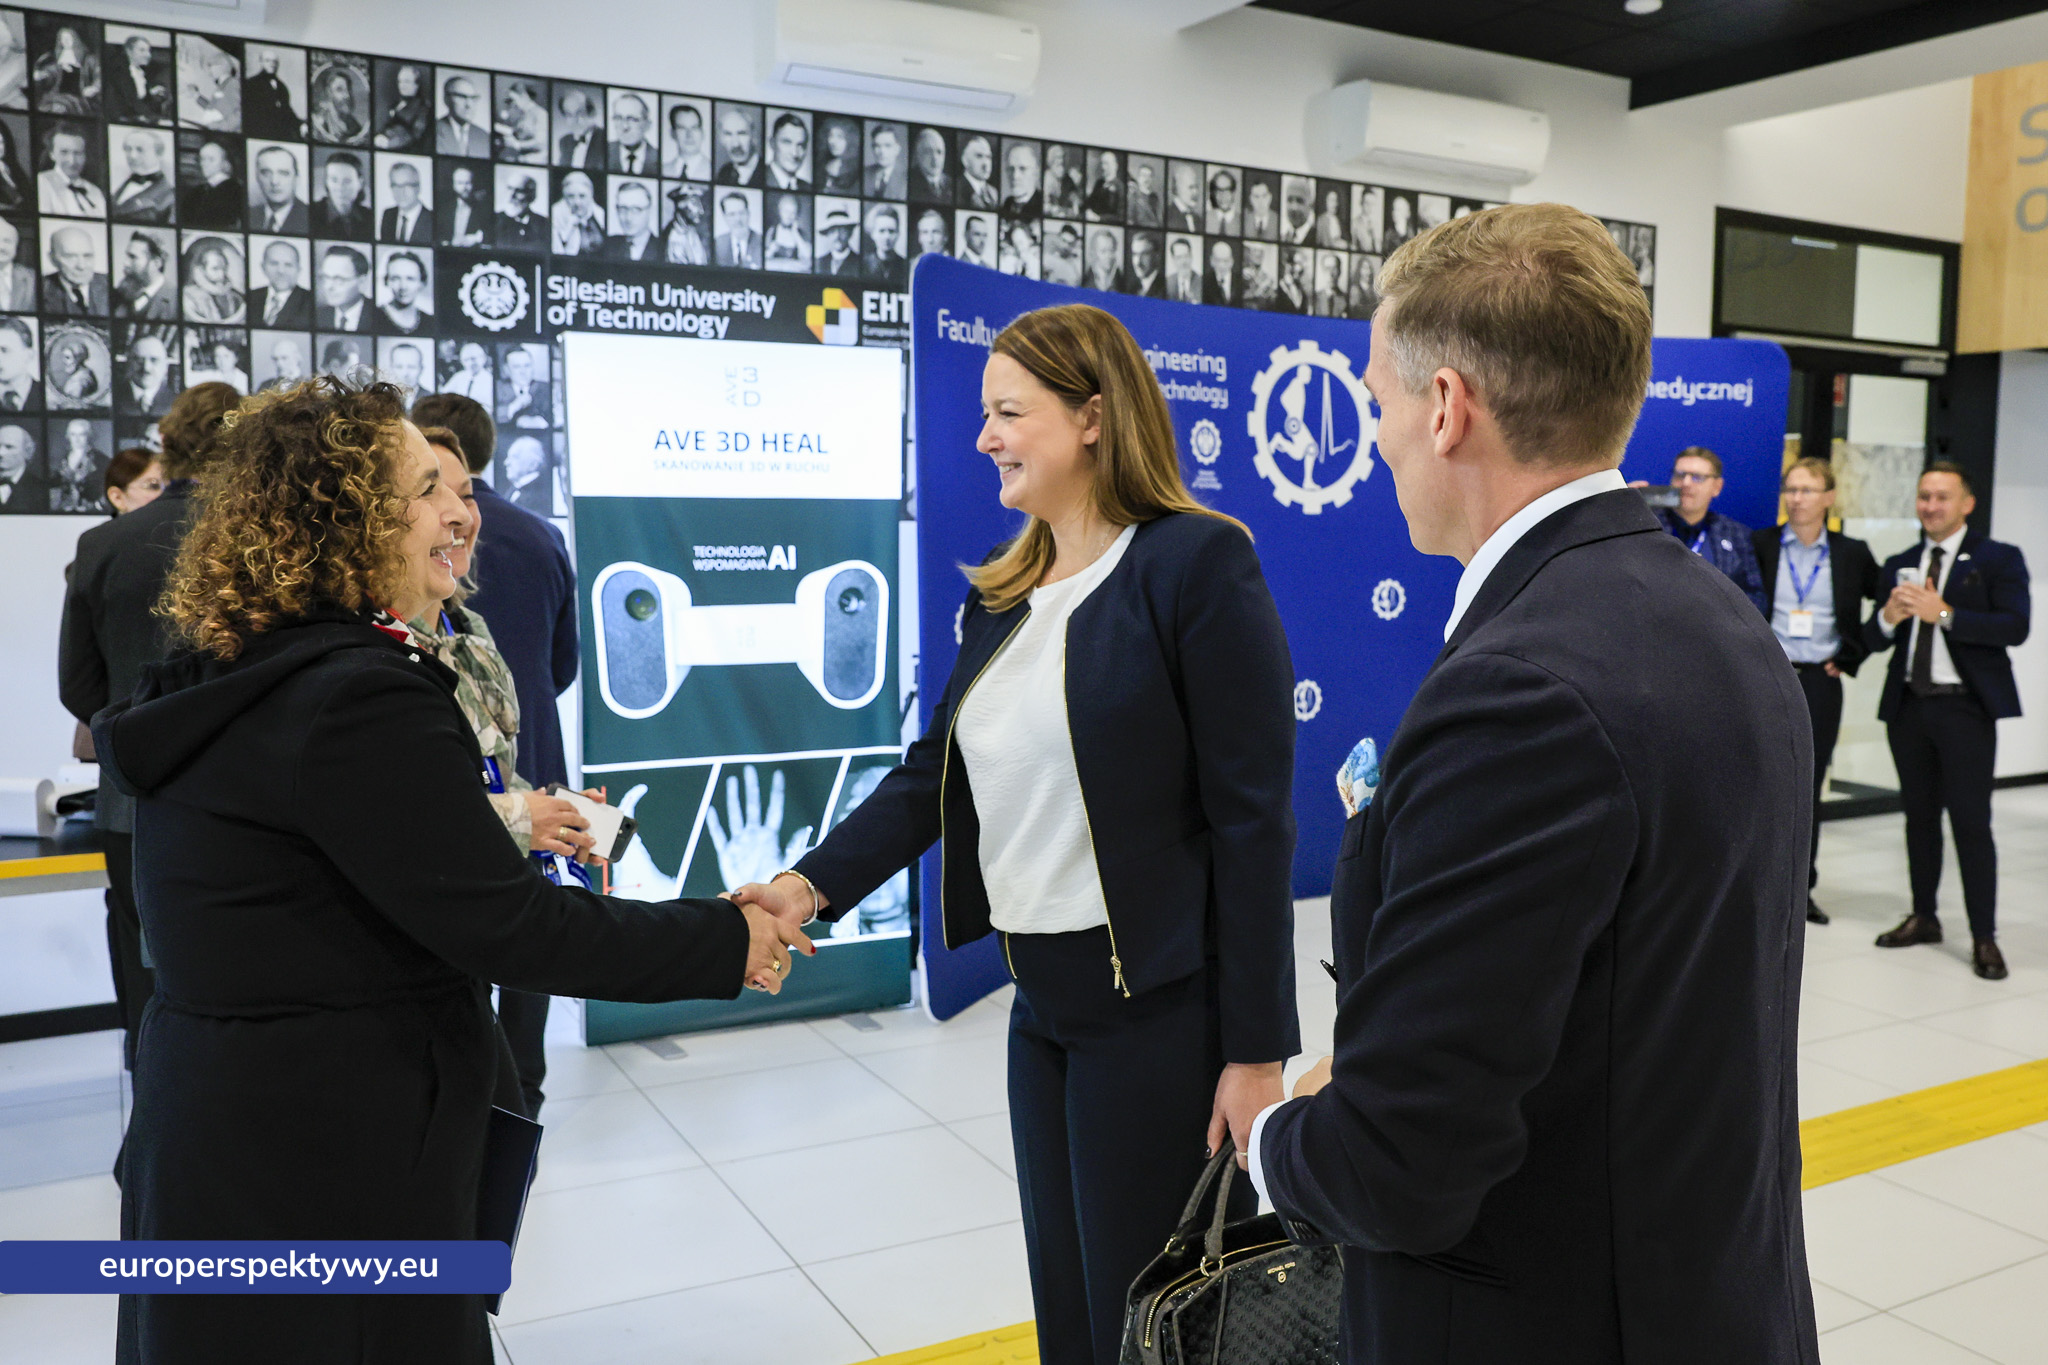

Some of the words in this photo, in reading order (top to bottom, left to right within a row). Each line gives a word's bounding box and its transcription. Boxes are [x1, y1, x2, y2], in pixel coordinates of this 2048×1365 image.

[546, 275, 646, 305] Silesian
[651, 282, 777, 319] University
[546, 301, 578, 326] of
[580, 303, 730, 339] Technology
[654, 430, 706, 451] AVE
[716, 431, 750, 452] 3D
[762, 433, 828, 454] HEAL
[653, 458, 744, 472] SKANOWANIE
[770, 461, 782, 472] W
[786, 461, 831, 473] RUCHU
[693, 545, 767, 558] TECHNOLOGIA
[767, 544, 797, 570] AI
[693, 559, 768, 571] WSPOMAGANA
